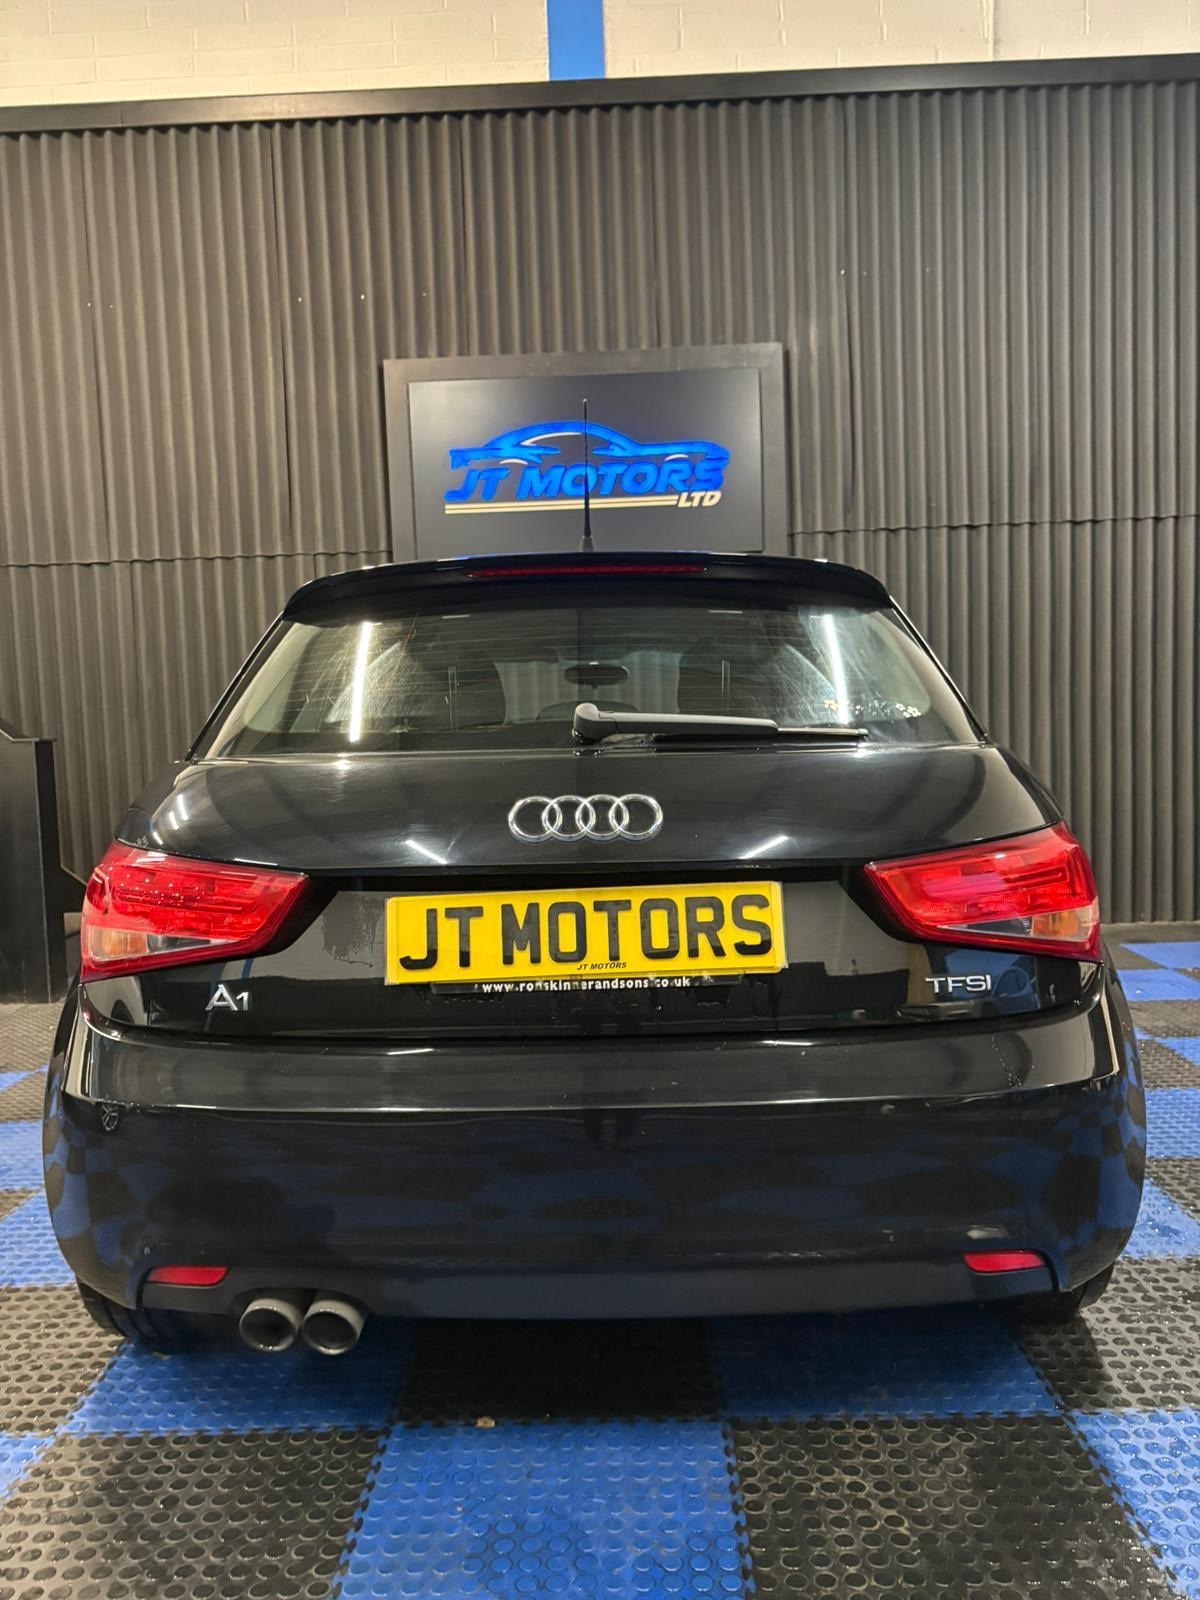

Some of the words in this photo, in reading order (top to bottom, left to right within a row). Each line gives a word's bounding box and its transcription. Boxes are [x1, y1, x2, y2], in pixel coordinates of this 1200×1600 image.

[444, 467, 510, 502] JT
[516, 458, 725, 499] MOTORS
[677, 491, 721, 508] LTD
[399, 906, 483, 970] JT
[501, 894, 772, 965] MOTORS
[577, 963, 588, 971] JT
[589, 961, 627, 970] MOTORS
[925, 974, 992, 994] TFSI
[205, 983, 249, 1011] A1
